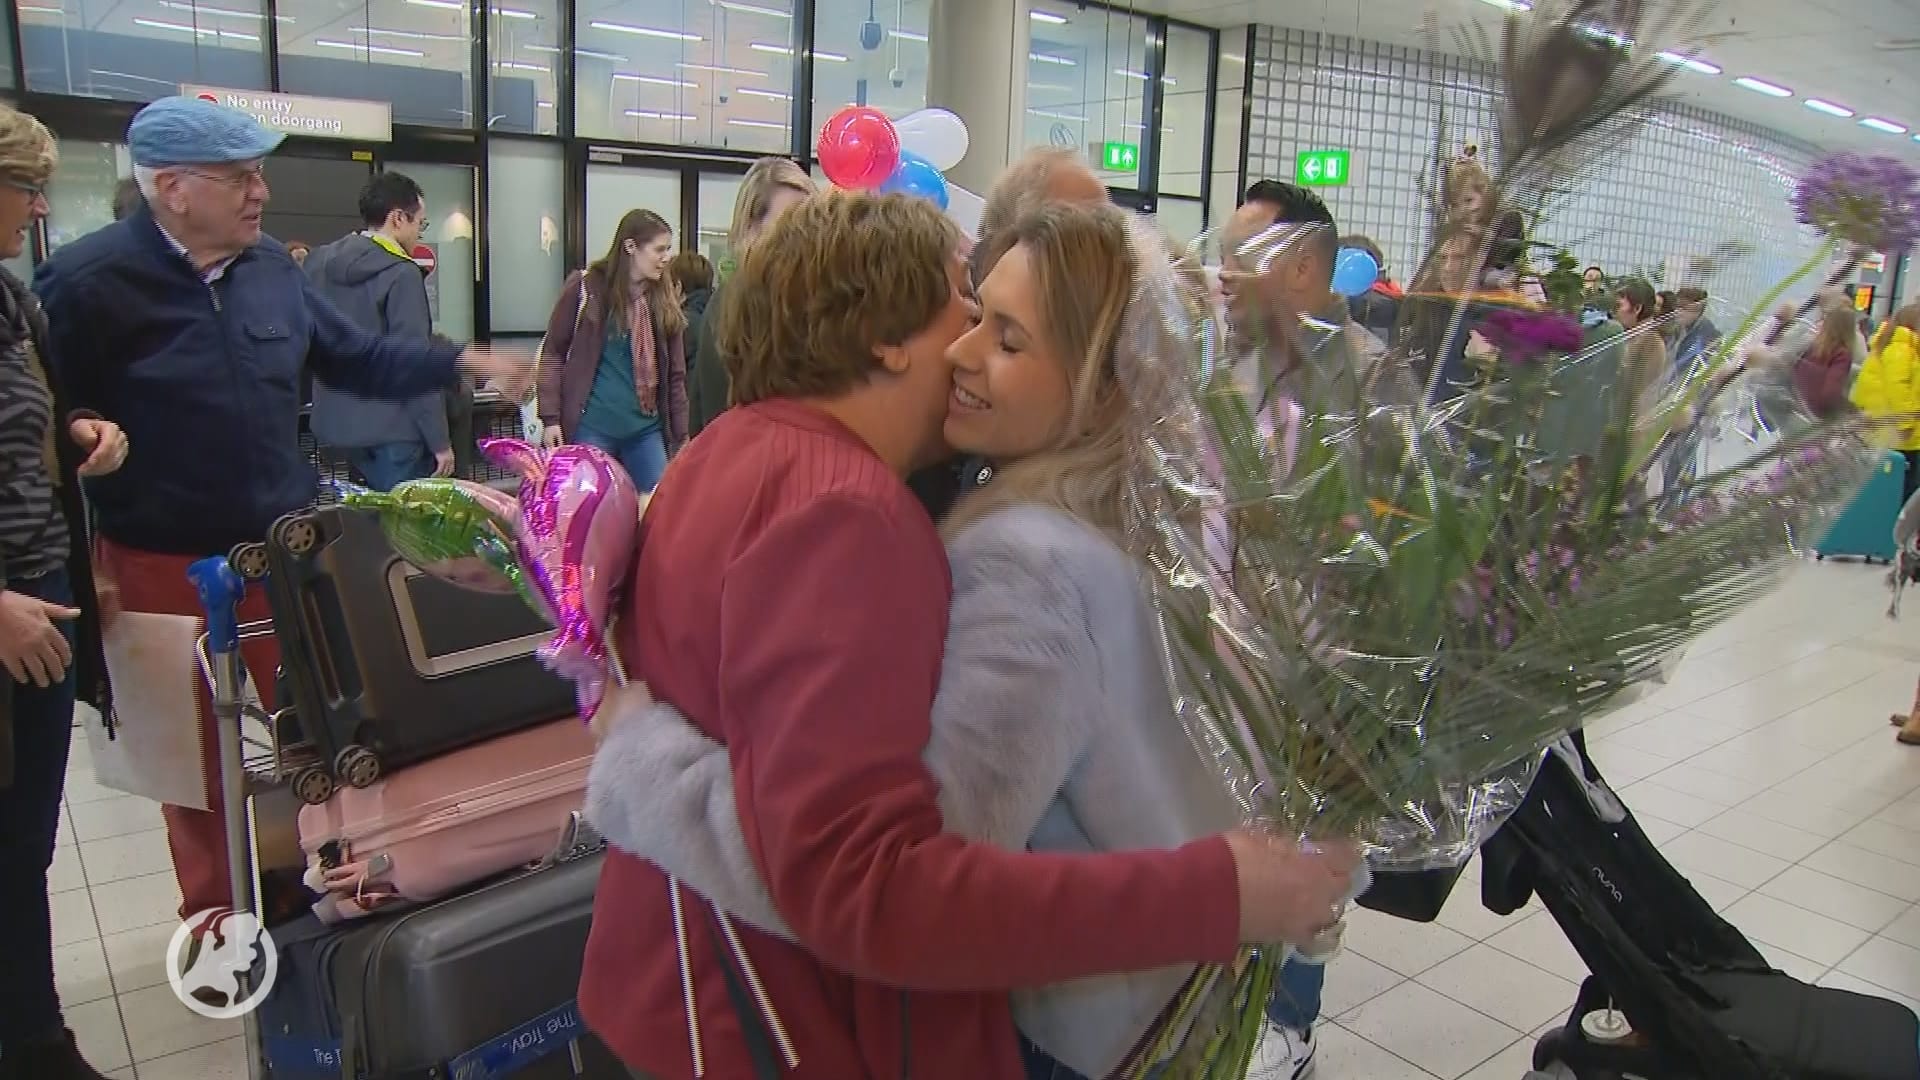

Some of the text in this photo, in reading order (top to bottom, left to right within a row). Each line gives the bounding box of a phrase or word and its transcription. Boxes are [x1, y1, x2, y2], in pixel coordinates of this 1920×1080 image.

[227, 95, 292, 113] No entry
[271, 112, 342, 132] doorgang
[1592, 866, 1623, 903] nuna
[546, 1011, 576, 1033] The
[313, 1048, 334, 1065] The
